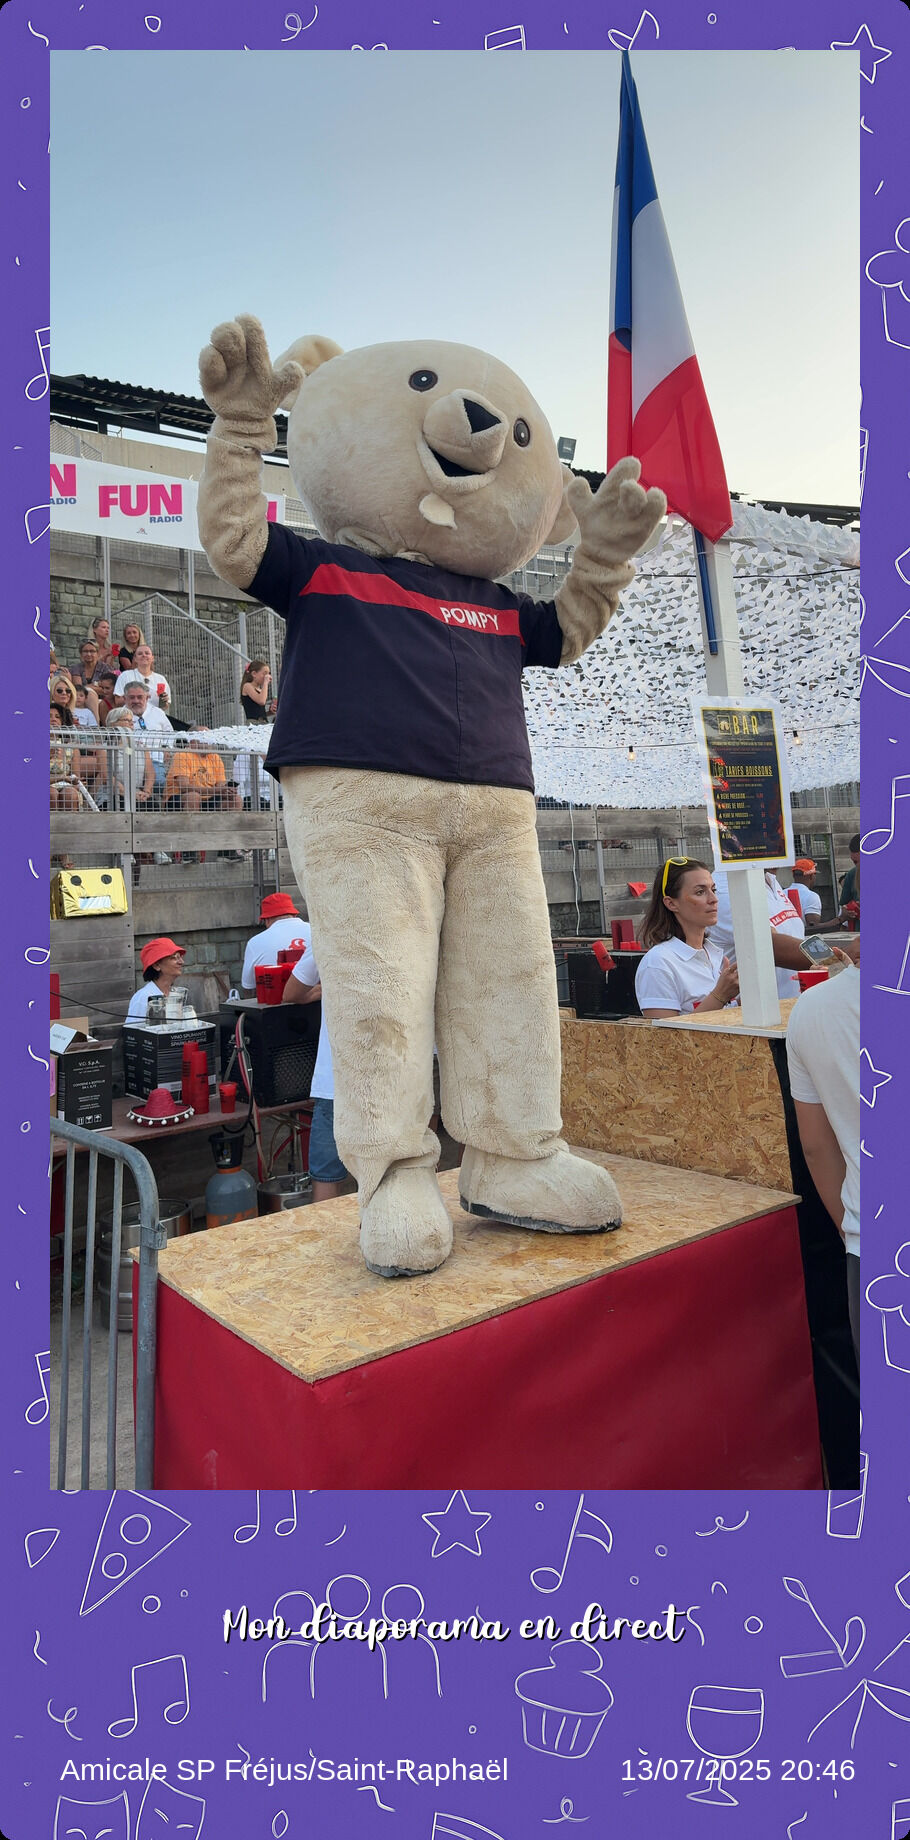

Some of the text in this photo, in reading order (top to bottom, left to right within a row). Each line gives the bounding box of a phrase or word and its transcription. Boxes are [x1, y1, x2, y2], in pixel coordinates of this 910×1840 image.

[50, 497, 77, 505] ADIO
[98, 484, 183, 518] FUN
[149, 515, 183, 524] RADIO
[440, 606, 499, 631] POMPY
[732, 714, 759, 735] BAR
